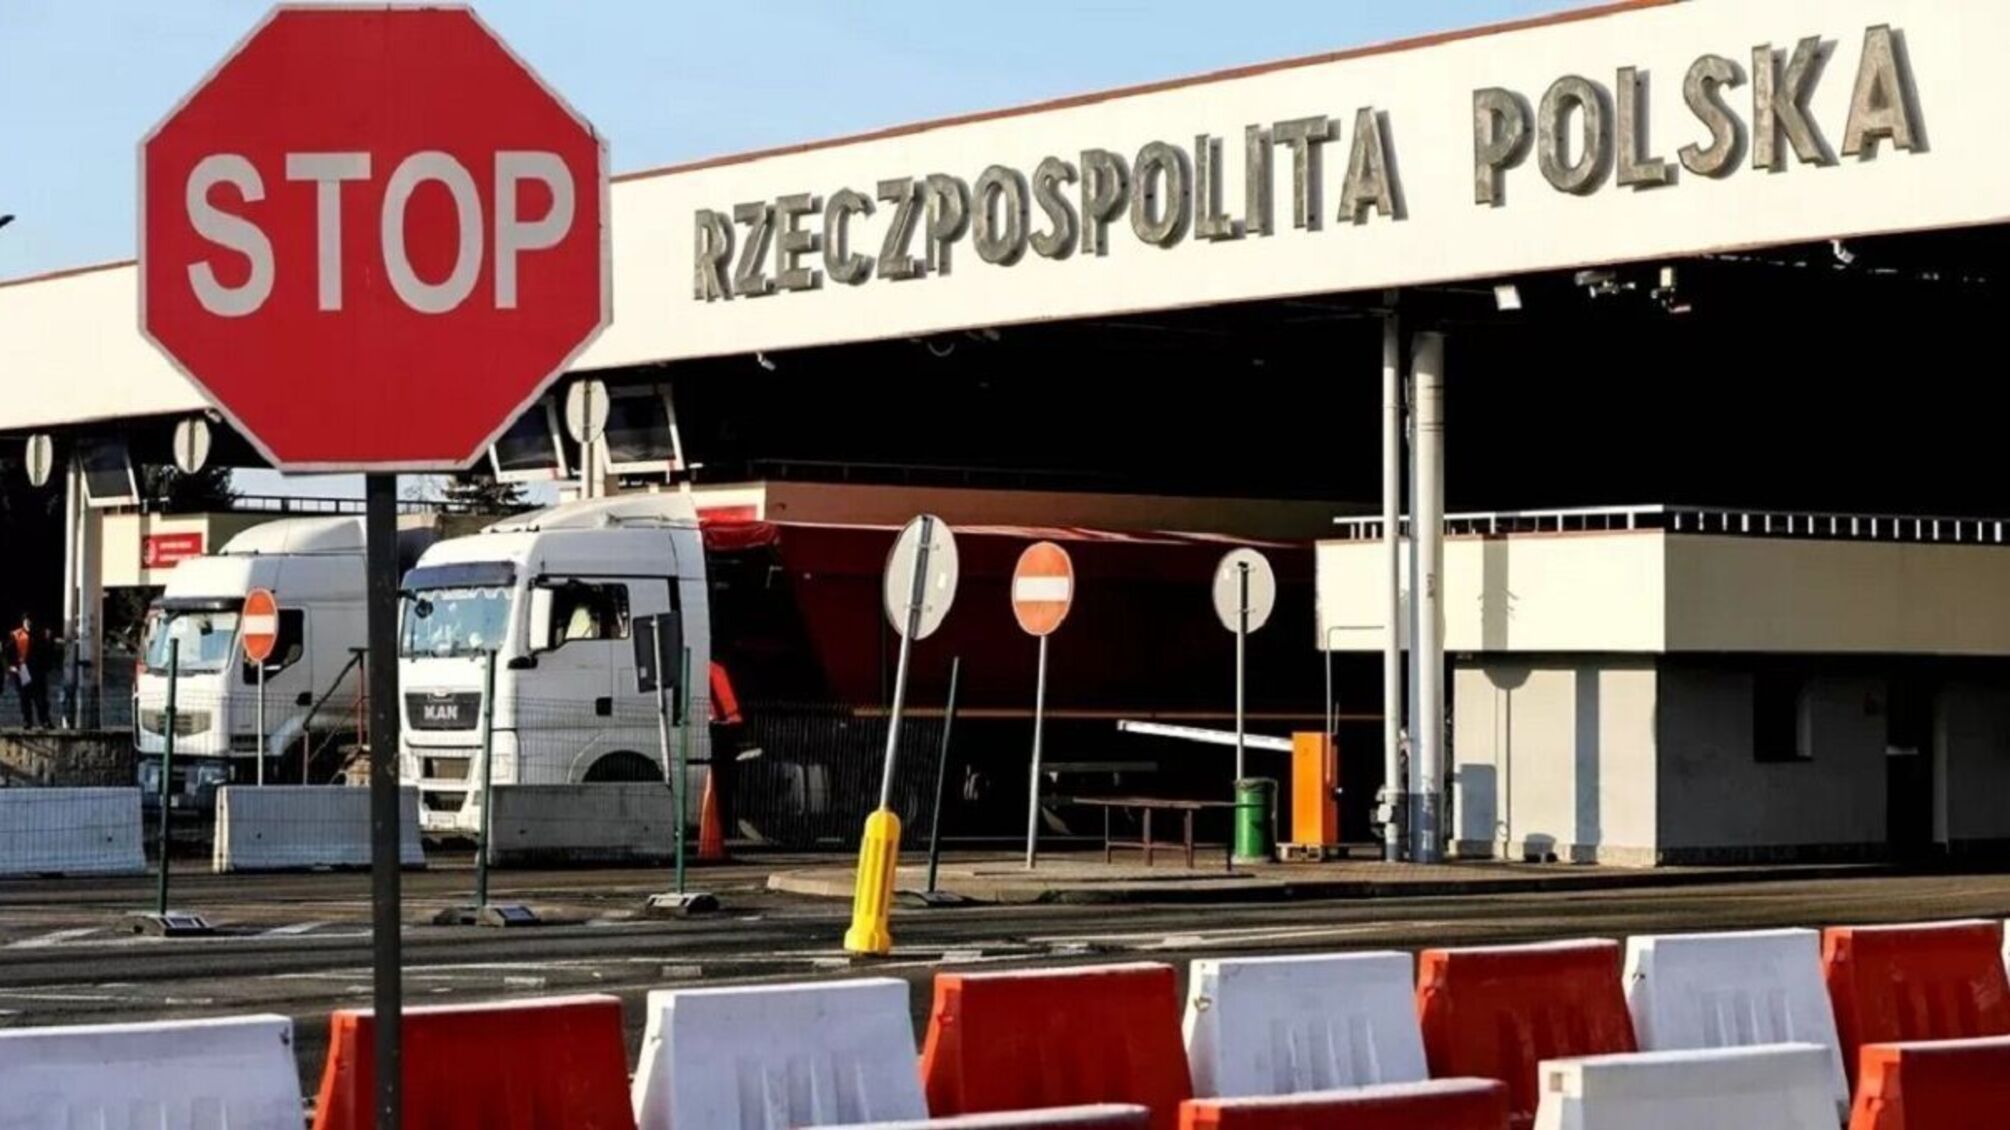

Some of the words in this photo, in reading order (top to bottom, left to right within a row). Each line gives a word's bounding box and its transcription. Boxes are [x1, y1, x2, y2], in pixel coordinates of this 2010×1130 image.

[186, 150, 575, 317] STOP
[693, 106, 1407, 303] RZECZPOSPOLITA
[1472, 23, 1929, 207] POLSKA
[424, 705, 458, 720] MAN
